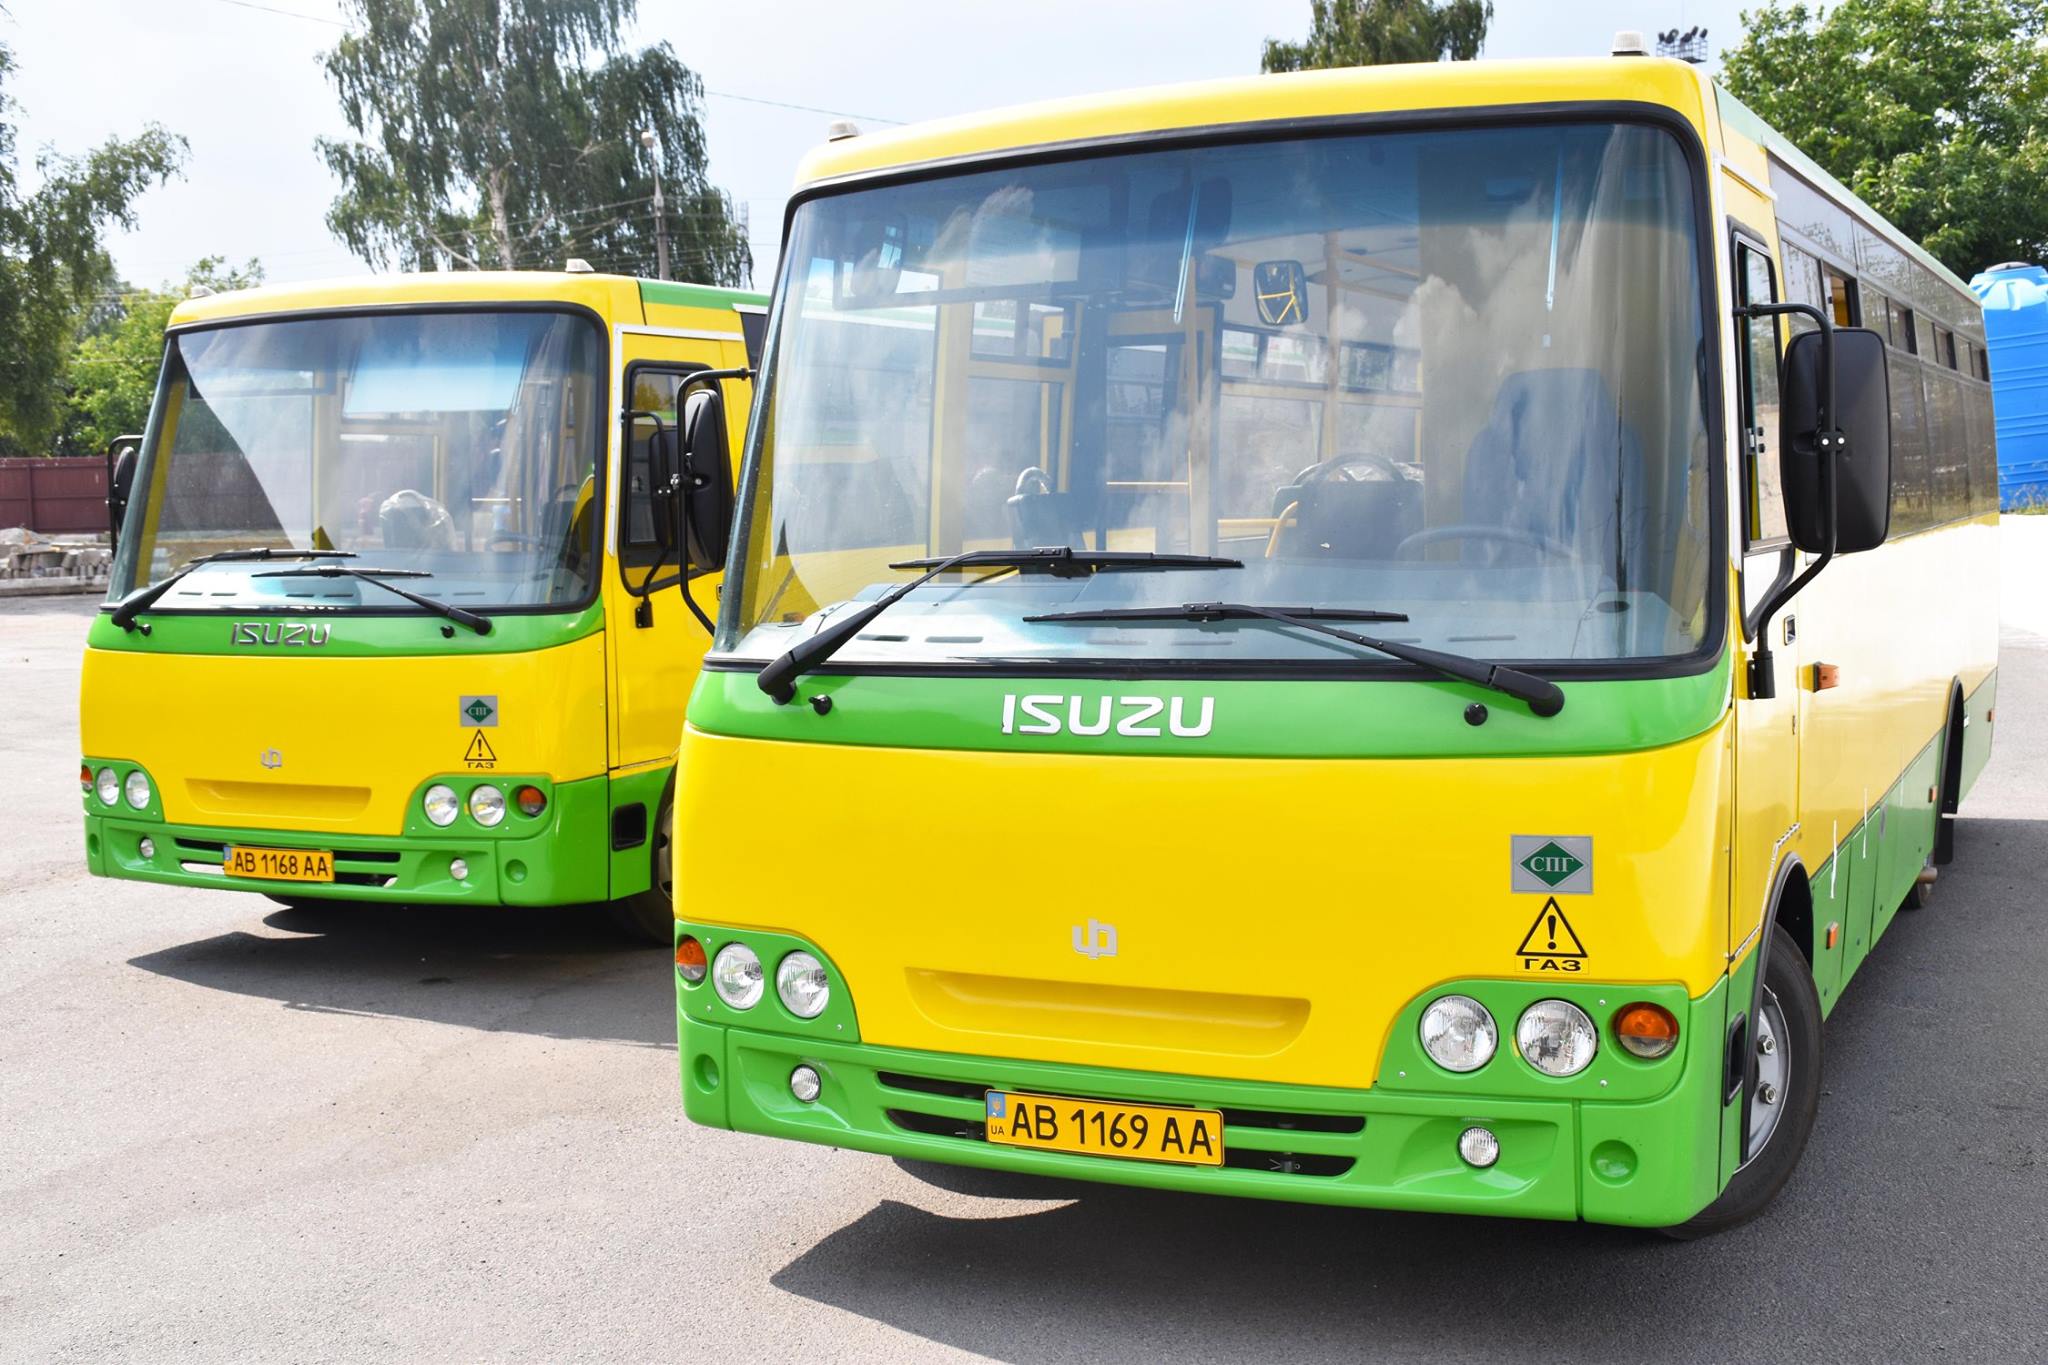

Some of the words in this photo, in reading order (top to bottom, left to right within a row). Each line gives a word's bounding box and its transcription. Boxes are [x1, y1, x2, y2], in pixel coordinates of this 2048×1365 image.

[231, 622, 331, 646] ISUZU
[1002, 694, 1215, 737] ISUZU
[234, 852, 256, 873] AB
[261, 854, 298, 875] 1168
[303, 856, 329, 877] AA
[1530, 856, 1574, 872] СПГ
[1524, 958, 1581, 972] ГАЗ
[990, 1125, 1005, 1136] UA
[1011, 1103, 1058, 1140] AB
[1070, 1108, 1149, 1150] 1169
[1160, 1117, 1213, 1156] AA
